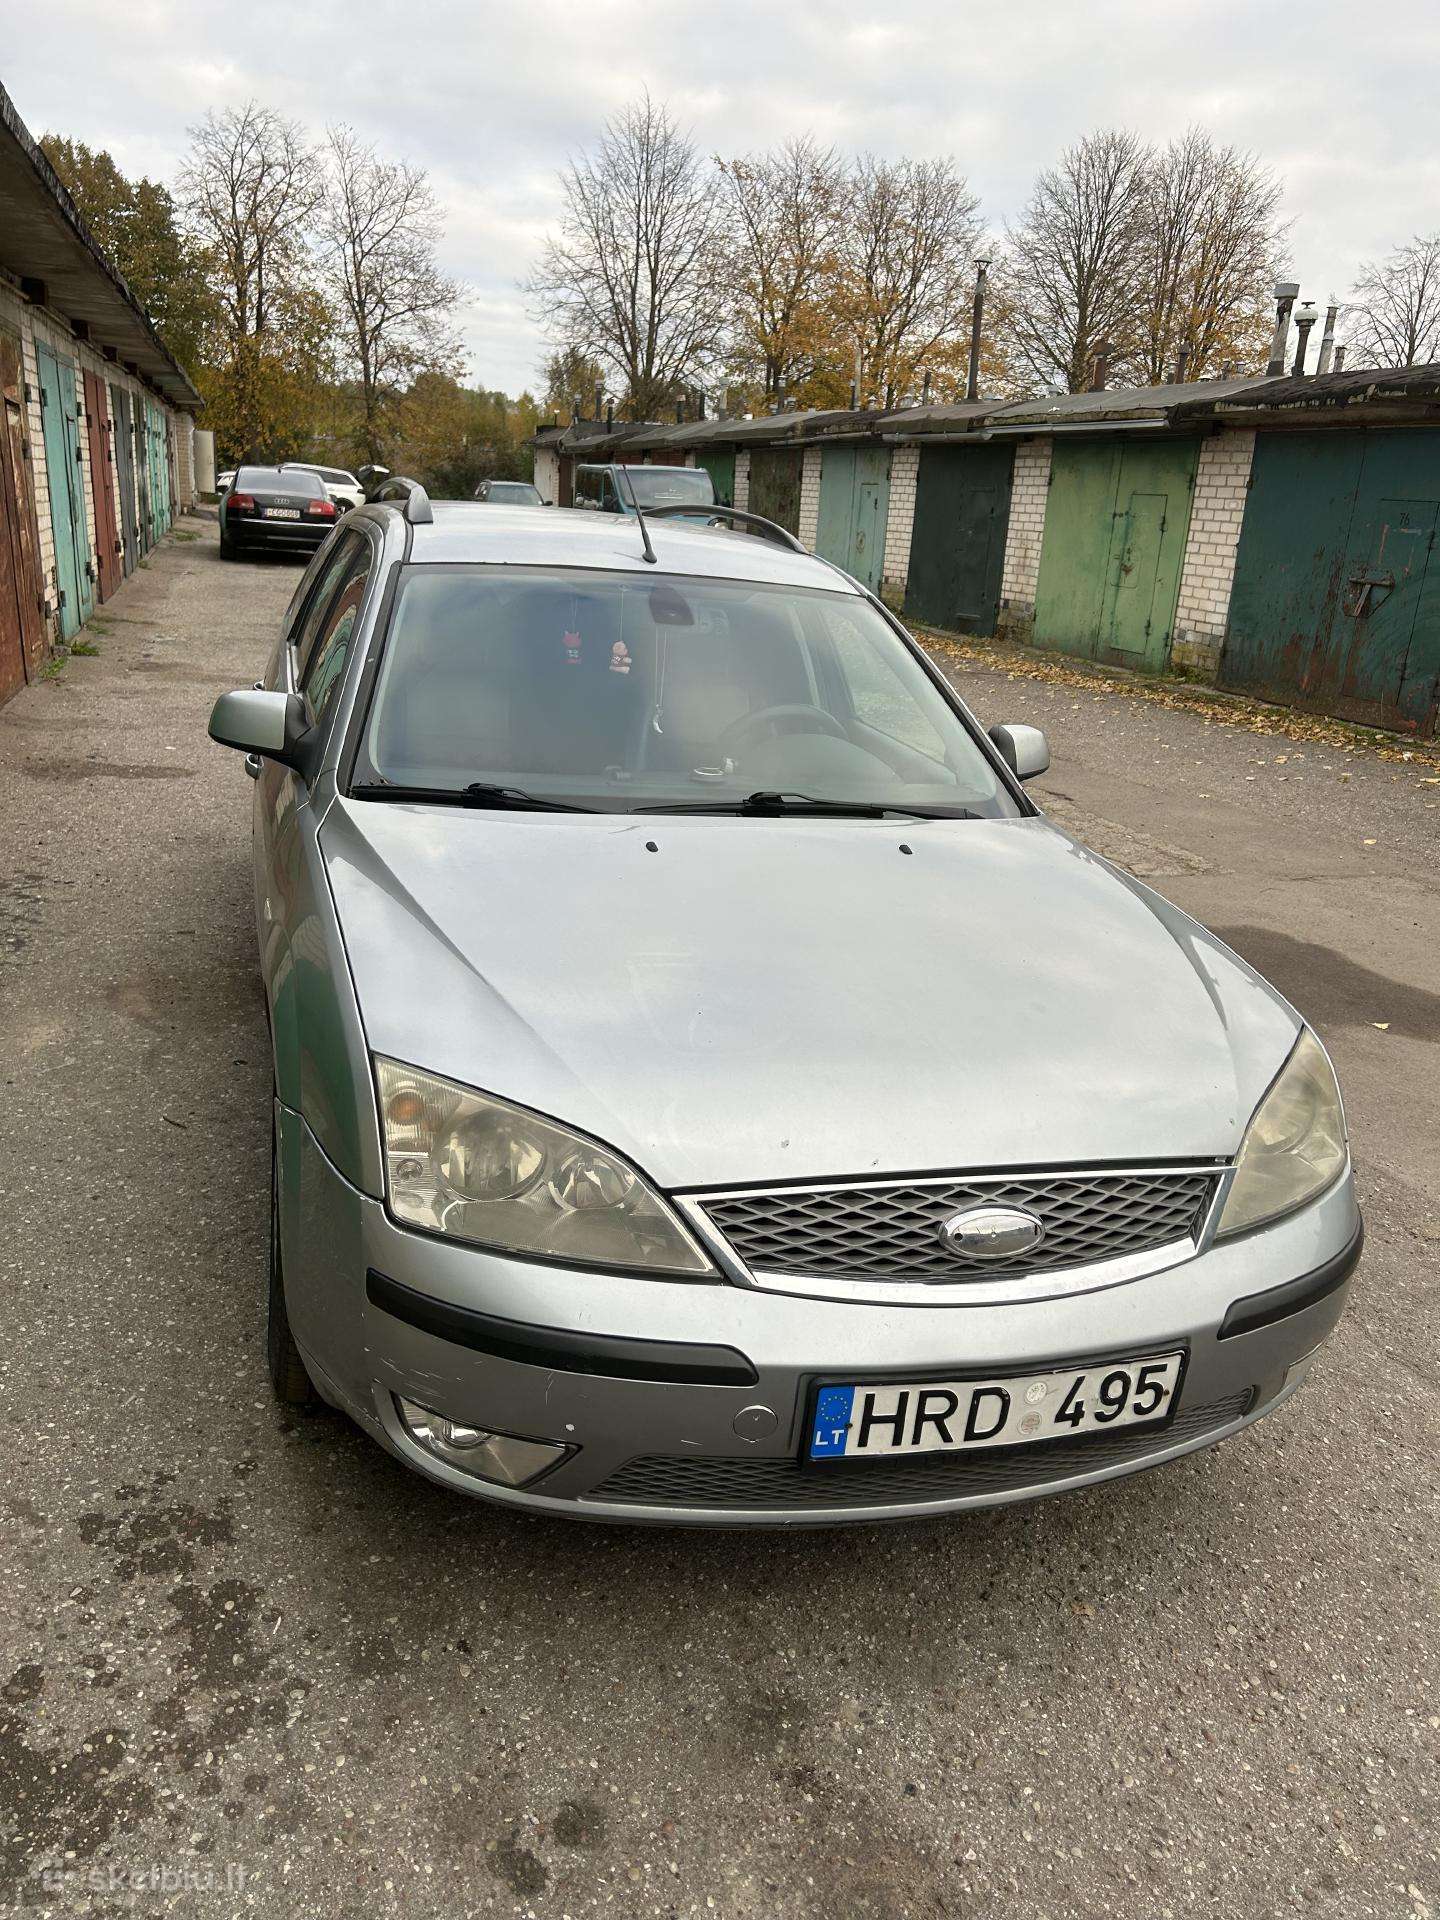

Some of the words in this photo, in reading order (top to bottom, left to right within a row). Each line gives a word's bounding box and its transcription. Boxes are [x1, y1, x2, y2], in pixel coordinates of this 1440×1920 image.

[857, 1386, 1011, 1448] HRD
[1053, 1364, 1169, 1427] 495
[816, 1429, 844, 1446] LT
